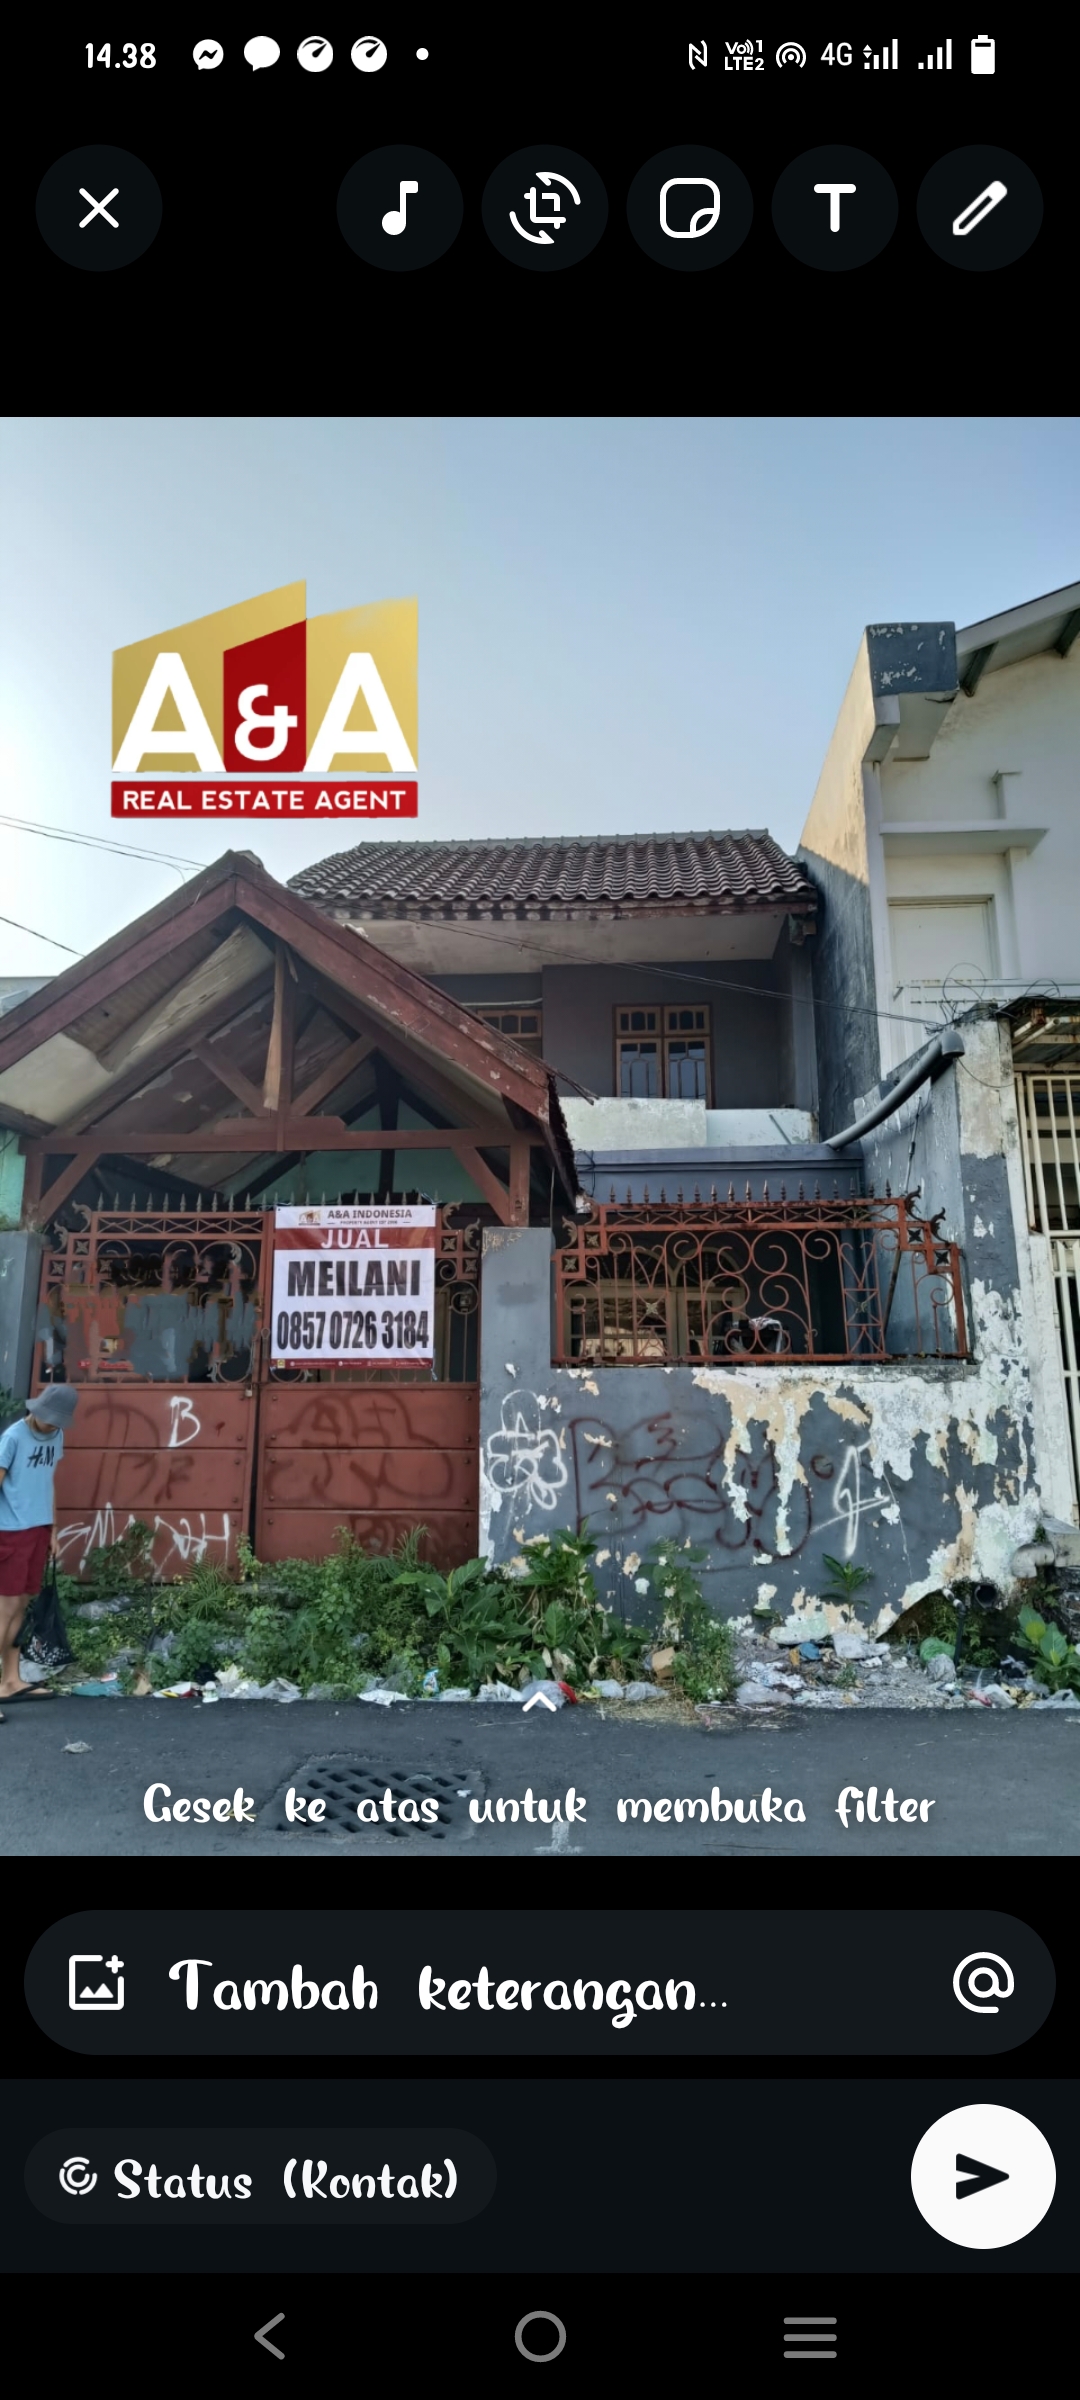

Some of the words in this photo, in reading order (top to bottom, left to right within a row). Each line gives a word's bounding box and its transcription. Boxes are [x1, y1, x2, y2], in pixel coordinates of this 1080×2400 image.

[352, 1209, 413, 1219] INDONESIA
[320, 1228, 390, 1250] JUAL
[287, 1259, 421, 1297] MEILANI
[276, 1310, 326, 1351] 0857
[329, 1310, 378, 1350] 0726
[381, 1309, 429, 1349] 3184
[26, 1445, 55, 1469] H&M
